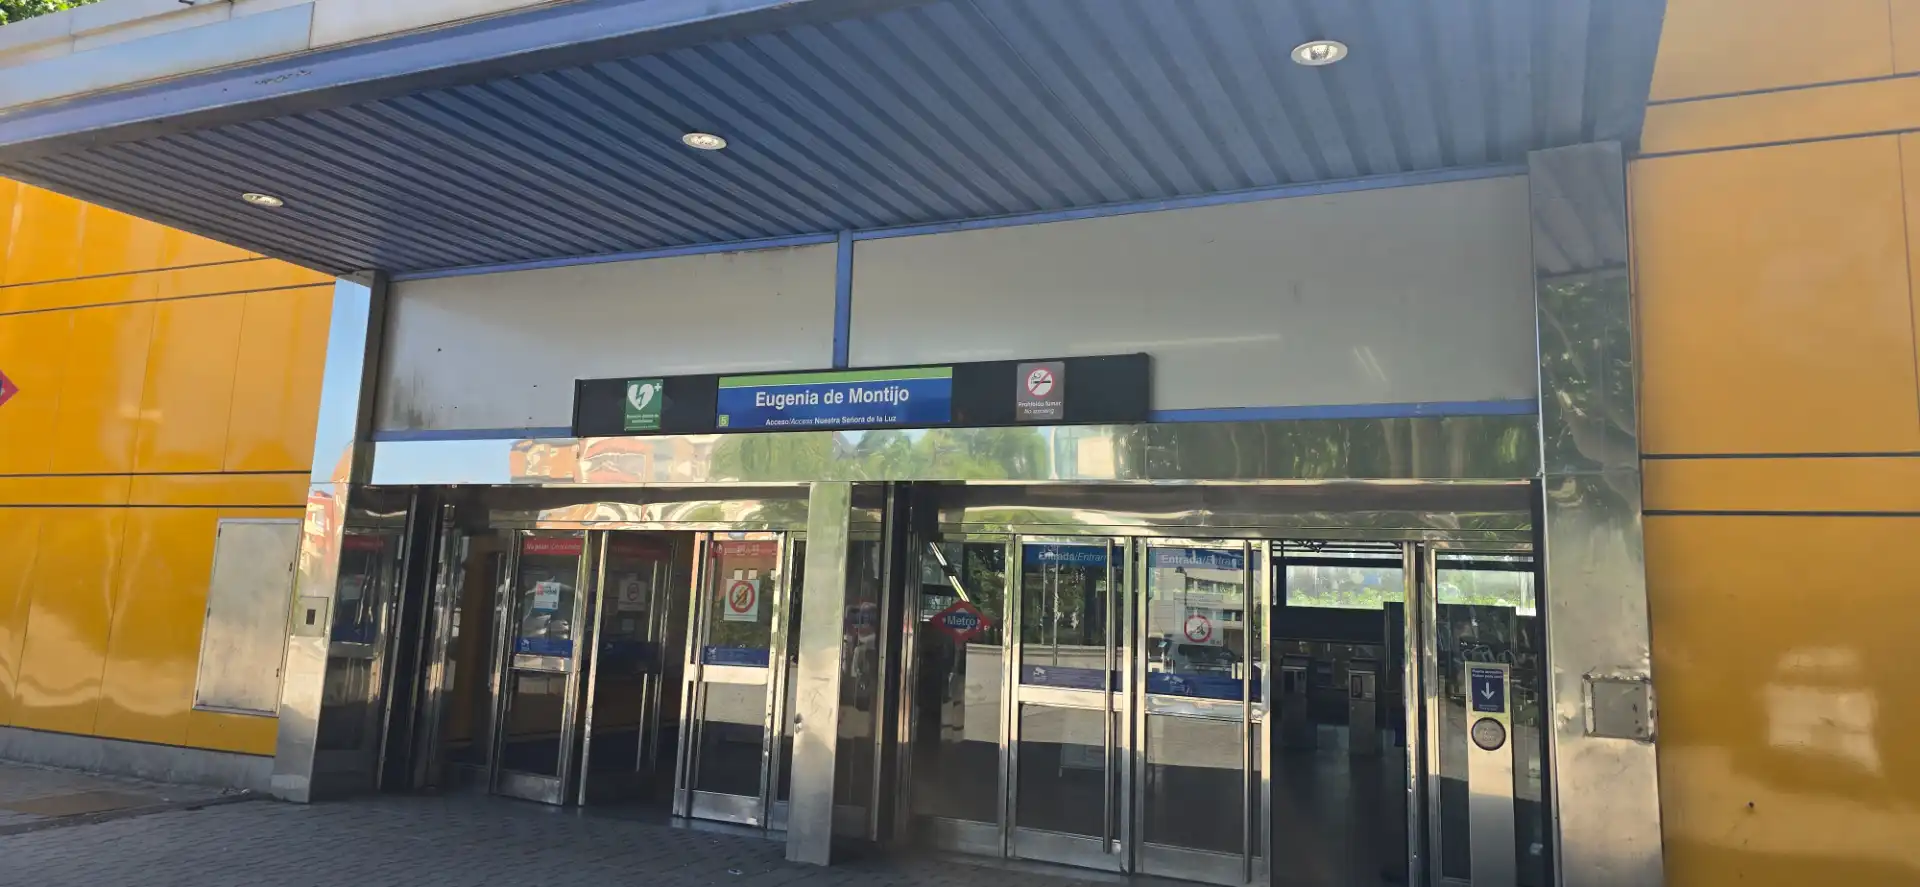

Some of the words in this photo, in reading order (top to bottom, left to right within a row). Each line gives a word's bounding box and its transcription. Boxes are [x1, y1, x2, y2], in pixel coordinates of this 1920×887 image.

[755, 389, 819, 410] Eugenia
[823, 388, 844, 404] de
[849, 386, 909, 406] Montijo
[720, 416, 728, 426] 5
[814, 416, 840, 425] Nuestra
[841, 414, 865, 424] Señora
[866, 414, 876, 423] de
[876, 414, 883, 422] la
[884, 413, 897, 422] Luz
[947, 615, 976, 626] Metro
